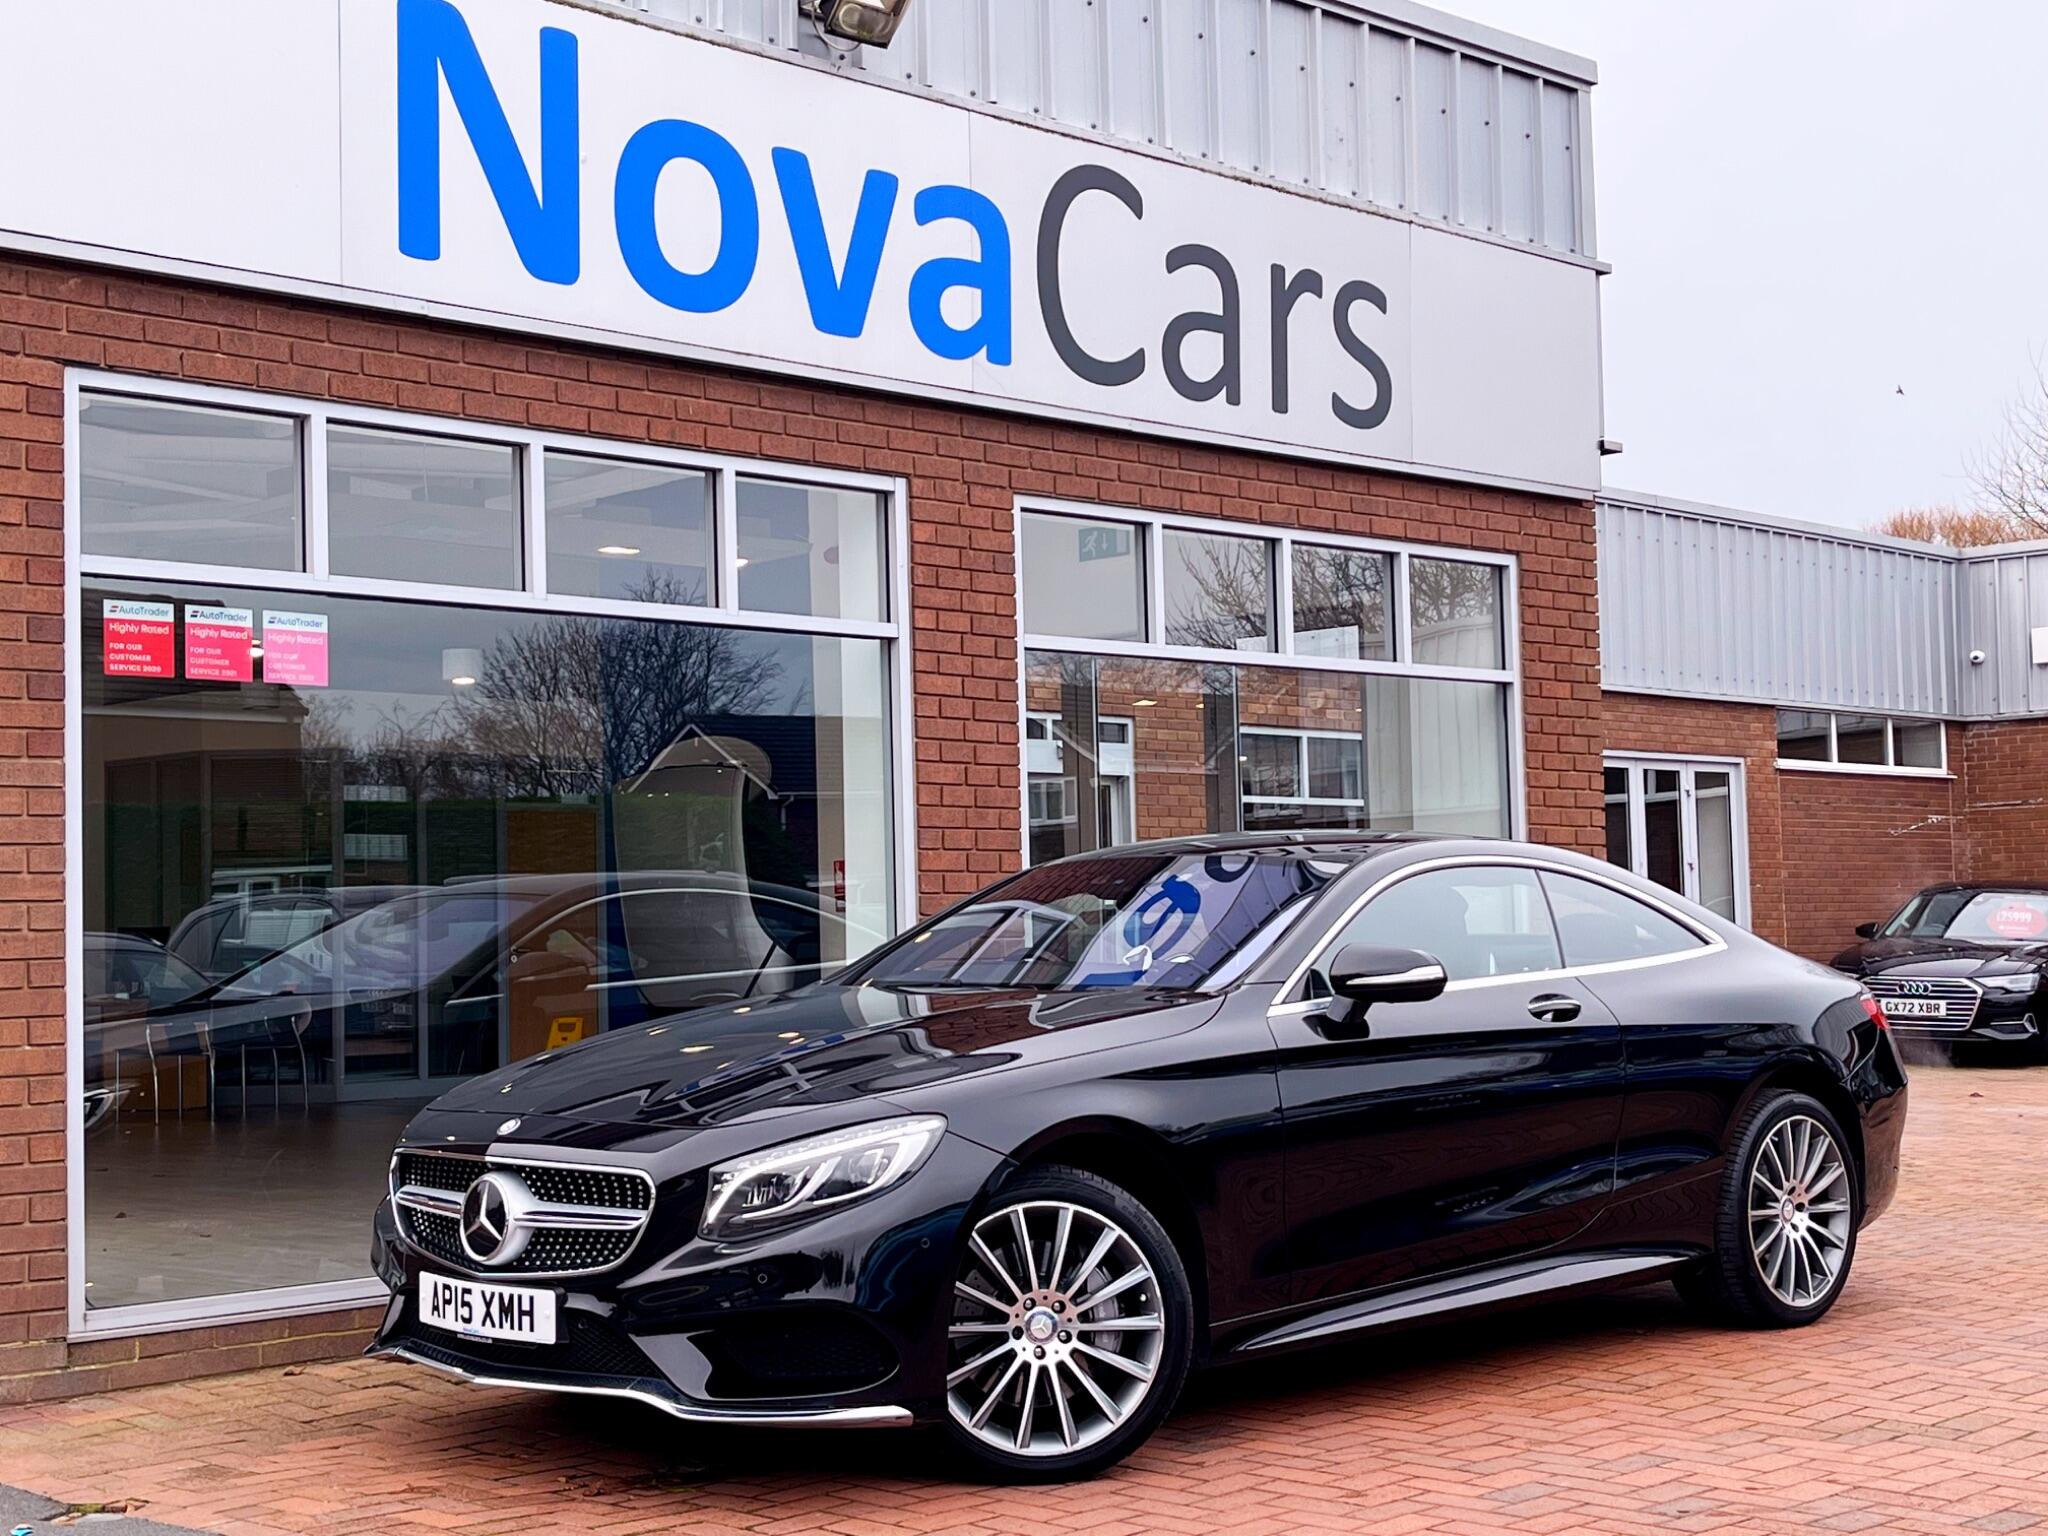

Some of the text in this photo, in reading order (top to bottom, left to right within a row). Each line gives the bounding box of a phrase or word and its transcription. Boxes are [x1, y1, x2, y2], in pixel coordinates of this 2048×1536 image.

[118, 605, 169, 617] AutoTrader
[199, 610, 248, 622] AutoTrader
[109, 622, 170, 635] Highly Rated
[190, 627, 248, 640] Highly Rated
[109, 642, 143, 651] FOR OUR
[109, 653, 152, 662] CUSTOMER
[109, 663, 142, 673] SERVICE
[1885, 1001, 1941, 1014] GX72 XBR
[431, 1280, 535, 1333] AP15 XMH
